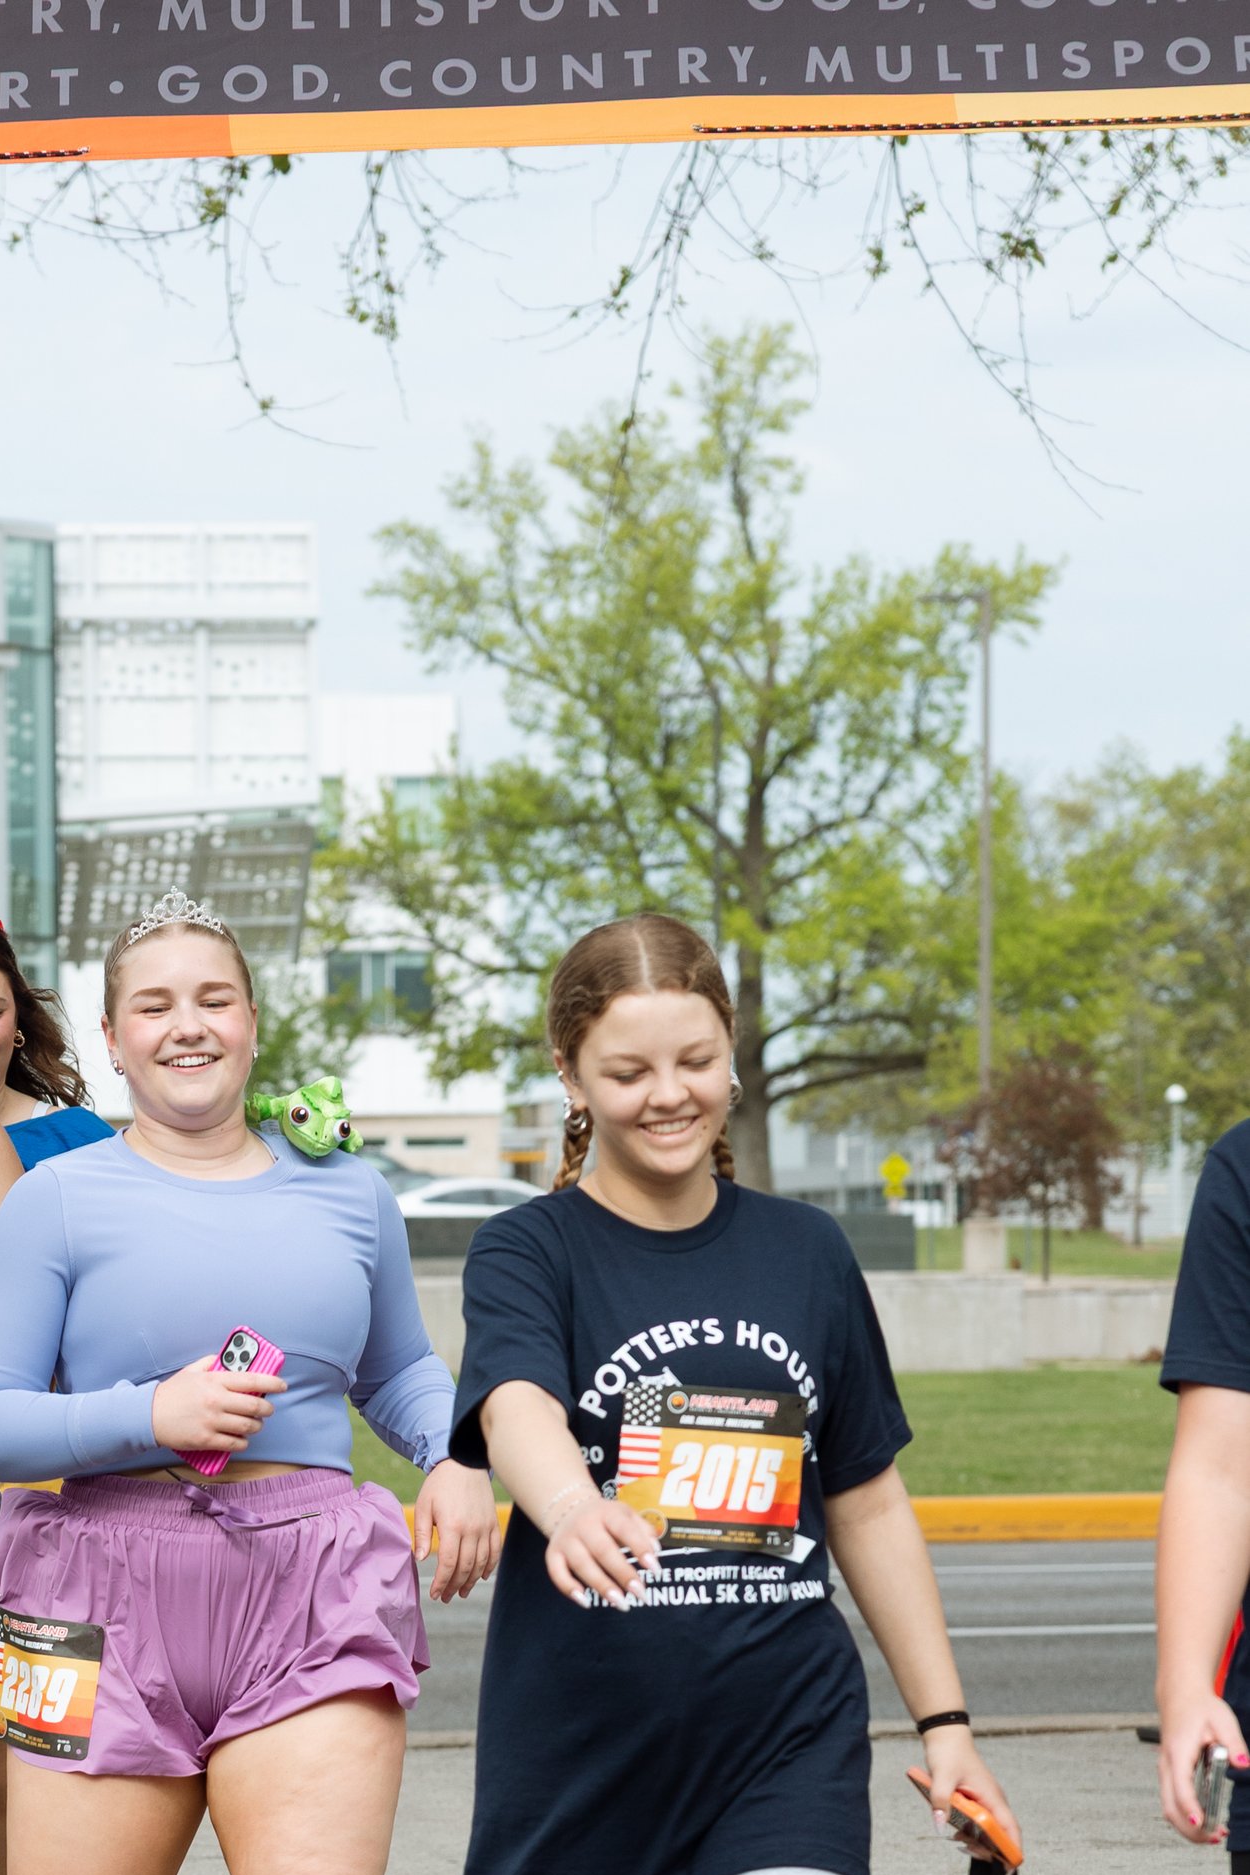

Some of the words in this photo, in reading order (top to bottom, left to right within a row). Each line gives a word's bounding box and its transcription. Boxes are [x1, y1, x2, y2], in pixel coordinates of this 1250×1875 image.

[157, 64, 341, 104] GOD,
[379, 45, 768, 97] COUNTRY,
[578, 1318, 724, 1419] POTTER'S
[659, 1441, 784, 1513] 2015
[675, 1566, 739, 1583] PROFFITT
[741, 1565, 786, 1580] LEGACY
[715, 1583, 739, 1604] 5K
[743, 1584, 758, 1604] &
[789, 1580, 825, 1601] RUN
[1, 1656, 79, 1723] 2289
